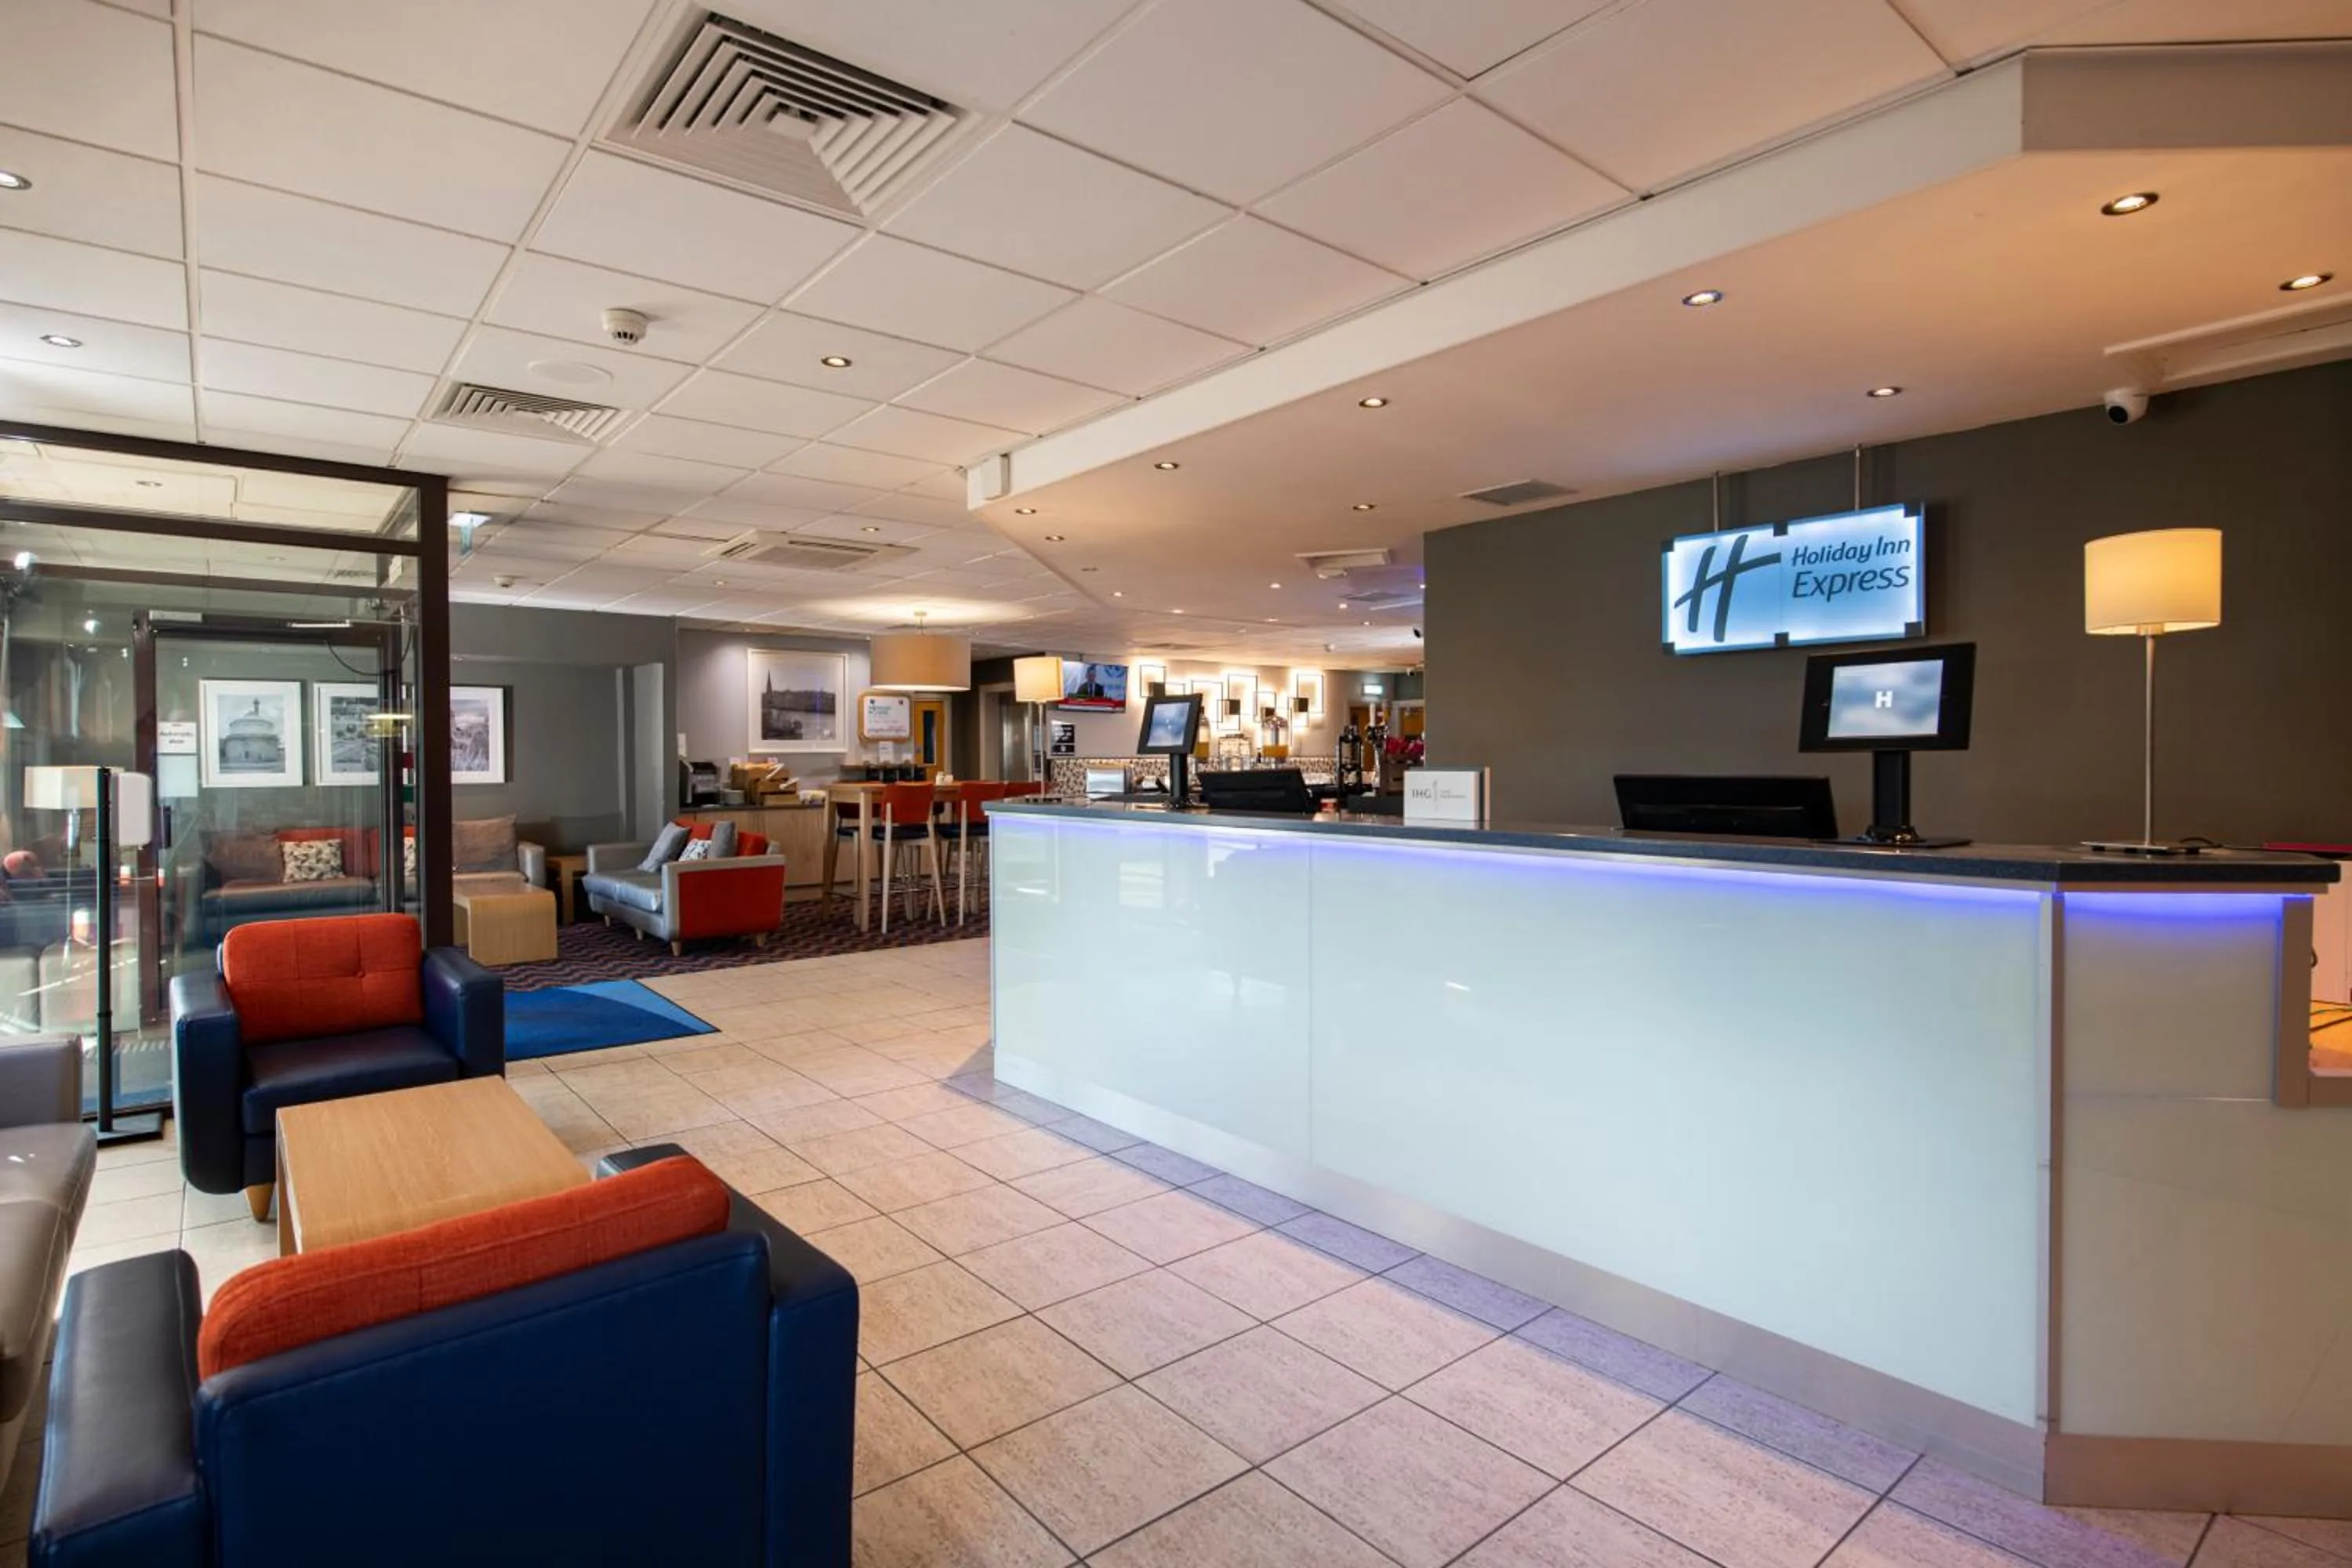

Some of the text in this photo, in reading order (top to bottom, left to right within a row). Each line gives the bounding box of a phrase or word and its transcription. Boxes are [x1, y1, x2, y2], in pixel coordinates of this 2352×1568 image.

[1791, 535, 1911, 567] Holiday Inn
[1792, 565, 1910, 602] Express
[1875, 691, 1893, 709] H
